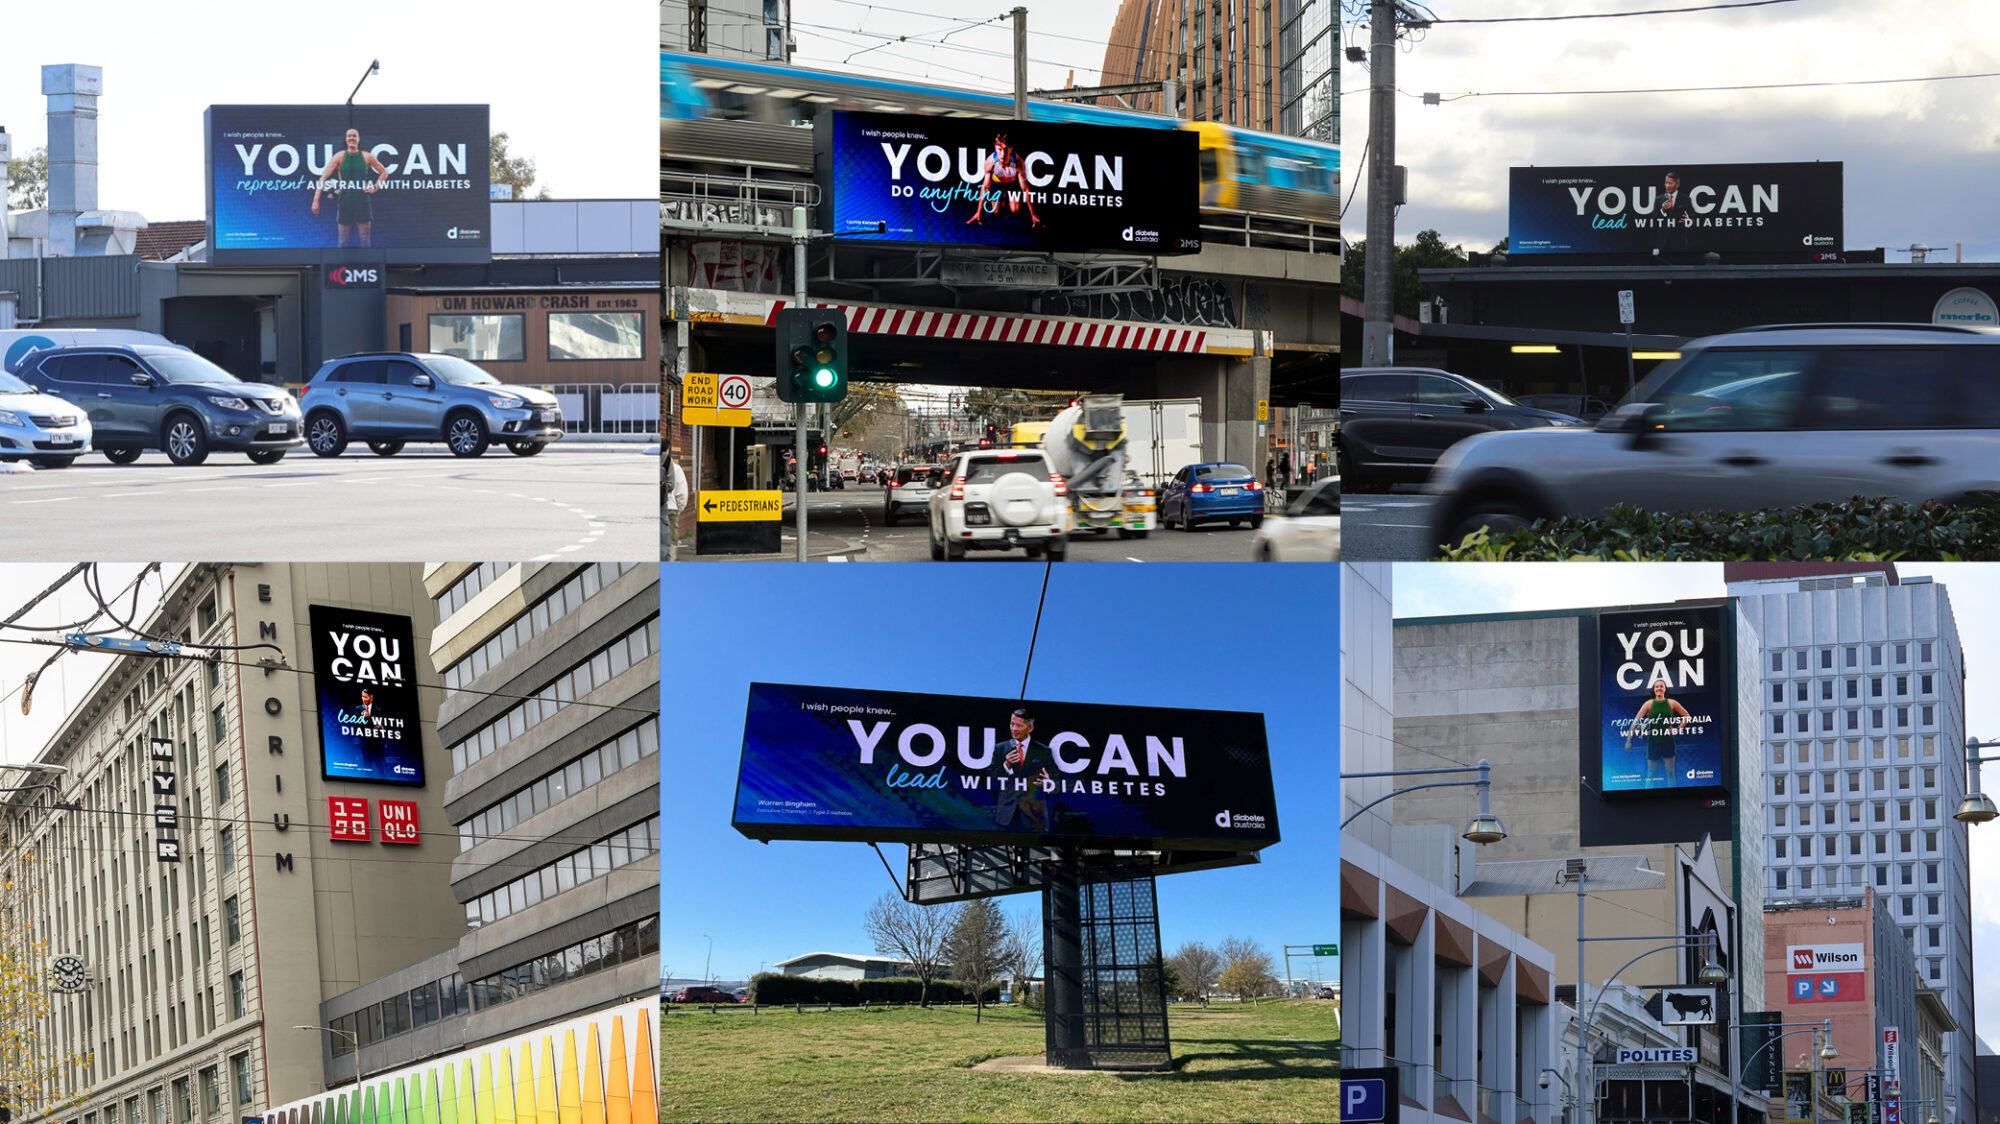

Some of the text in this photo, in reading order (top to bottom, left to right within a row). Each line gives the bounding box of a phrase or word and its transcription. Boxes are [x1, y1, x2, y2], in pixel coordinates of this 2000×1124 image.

[242, 132, 264, 140] people
[882, 131, 906, 140] people
[234, 143, 467, 177] YOU CAN
[881, 142, 1123, 191] YOU CAN
[236, 175, 471, 196] represent AUSTRALIA WITH DIABETES
[891, 181, 1123, 214] DO anything WITH DIABETES
[1568, 184, 1779, 216] YOU CAN
[1592, 214, 1764, 230] lead WITH DIABETES
[983, 264, 1048, 274] CLEARANCE
[471, 296, 536, 310] HOWARD
[540, 295, 590, 309] CRASH
[615, 299, 638, 308] 1963
[1940, 313, 1992, 322] merlo
[691, 376, 711, 385] END
[688, 386, 714, 396] ROAD
[724, 384, 746, 400] 40
[687, 396, 713, 404] WORK
[720, 500, 780, 512] PEDESTRIANS
[328, 631, 400, 662] YOU
[1616, 628, 1704, 660] YOU
[331, 657, 403, 687] CAN
[1616, 658, 1704, 690] CAN
[806, 702, 828, 712] wish
[830, 704, 864, 715] people
[337, 709, 404, 728] lead WITH
[1610, 713, 1712, 732] represent AUSTRALIA
[342, 726, 402, 740] DIABETES
[1620, 726, 1704, 737] WITH DIABETES
[847, 719, 1187, 778] YOU CAN
[886, 763, 1166, 797] lead WITH DIABETES
[152, 742, 178, 858] MYER
[784, 800, 816, 808] Bingham
[383, 804, 412, 821] UNI
[1232, 813, 1265, 822] diabetes
[384, 822, 416, 840] QLO
[1233, 821, 1266, 829] australia
[1816, 952, 1858, 963] Wilson
[1799, 982, 1810, 995] P
[1620, 1049, 1694, 1062] POLITES
[1348, 1085, 1367, 1114] P
